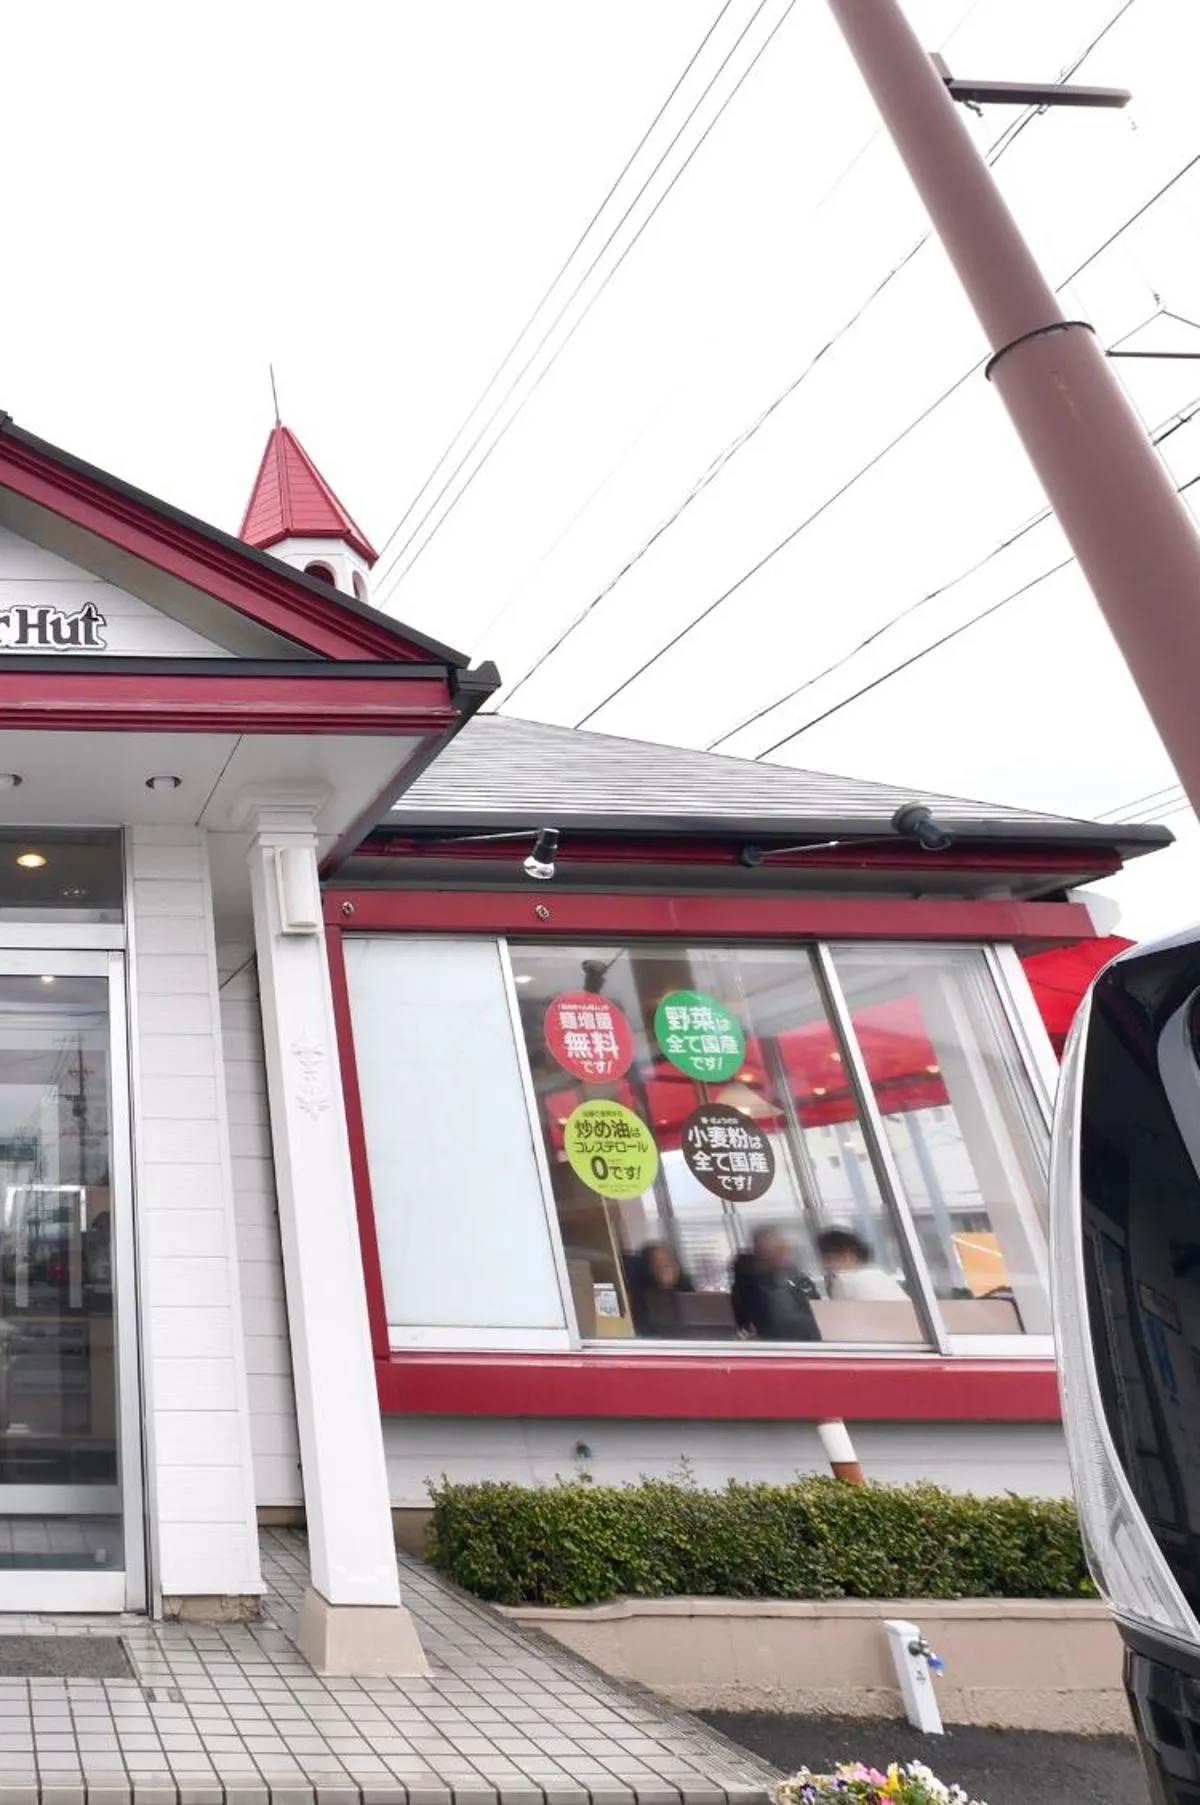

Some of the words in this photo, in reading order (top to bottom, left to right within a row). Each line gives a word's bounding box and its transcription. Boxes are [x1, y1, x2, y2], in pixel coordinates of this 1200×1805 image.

[13, 602, 104, 647] Hut
[665, 1006, 731, 1032] 野菜は
[564, 1030, 619, 1059] 無料
[665, 1033, 739, 1054] 全て国産
[574, 1118, 641, 1139] 炒め油は
[688, 1125, 763, 1149] 小麦粉は
[573, 1141, 648, 1153] コレステロール
[692, 1150, 770, 1173] 全て国産
